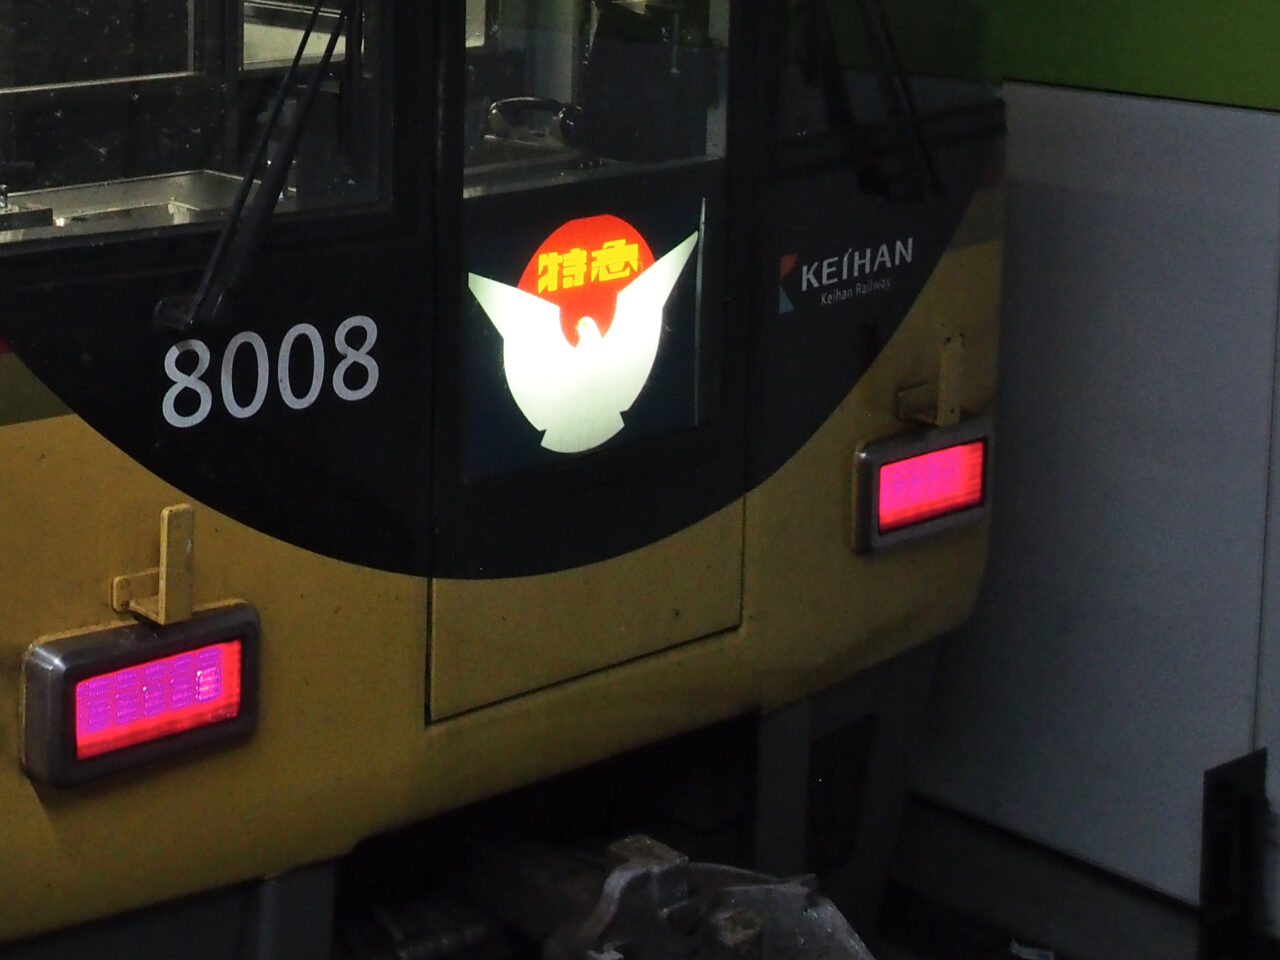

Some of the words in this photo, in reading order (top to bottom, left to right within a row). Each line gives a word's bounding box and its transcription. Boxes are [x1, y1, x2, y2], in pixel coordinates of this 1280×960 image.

[538, 239, 639, 294] 特急
[802, 237, 913, 292] KEIHAN
[821, 288, 853, 306] Keihan
[855, 279, 891, 296] Railway
[162, 315, 380, 429] 8008
